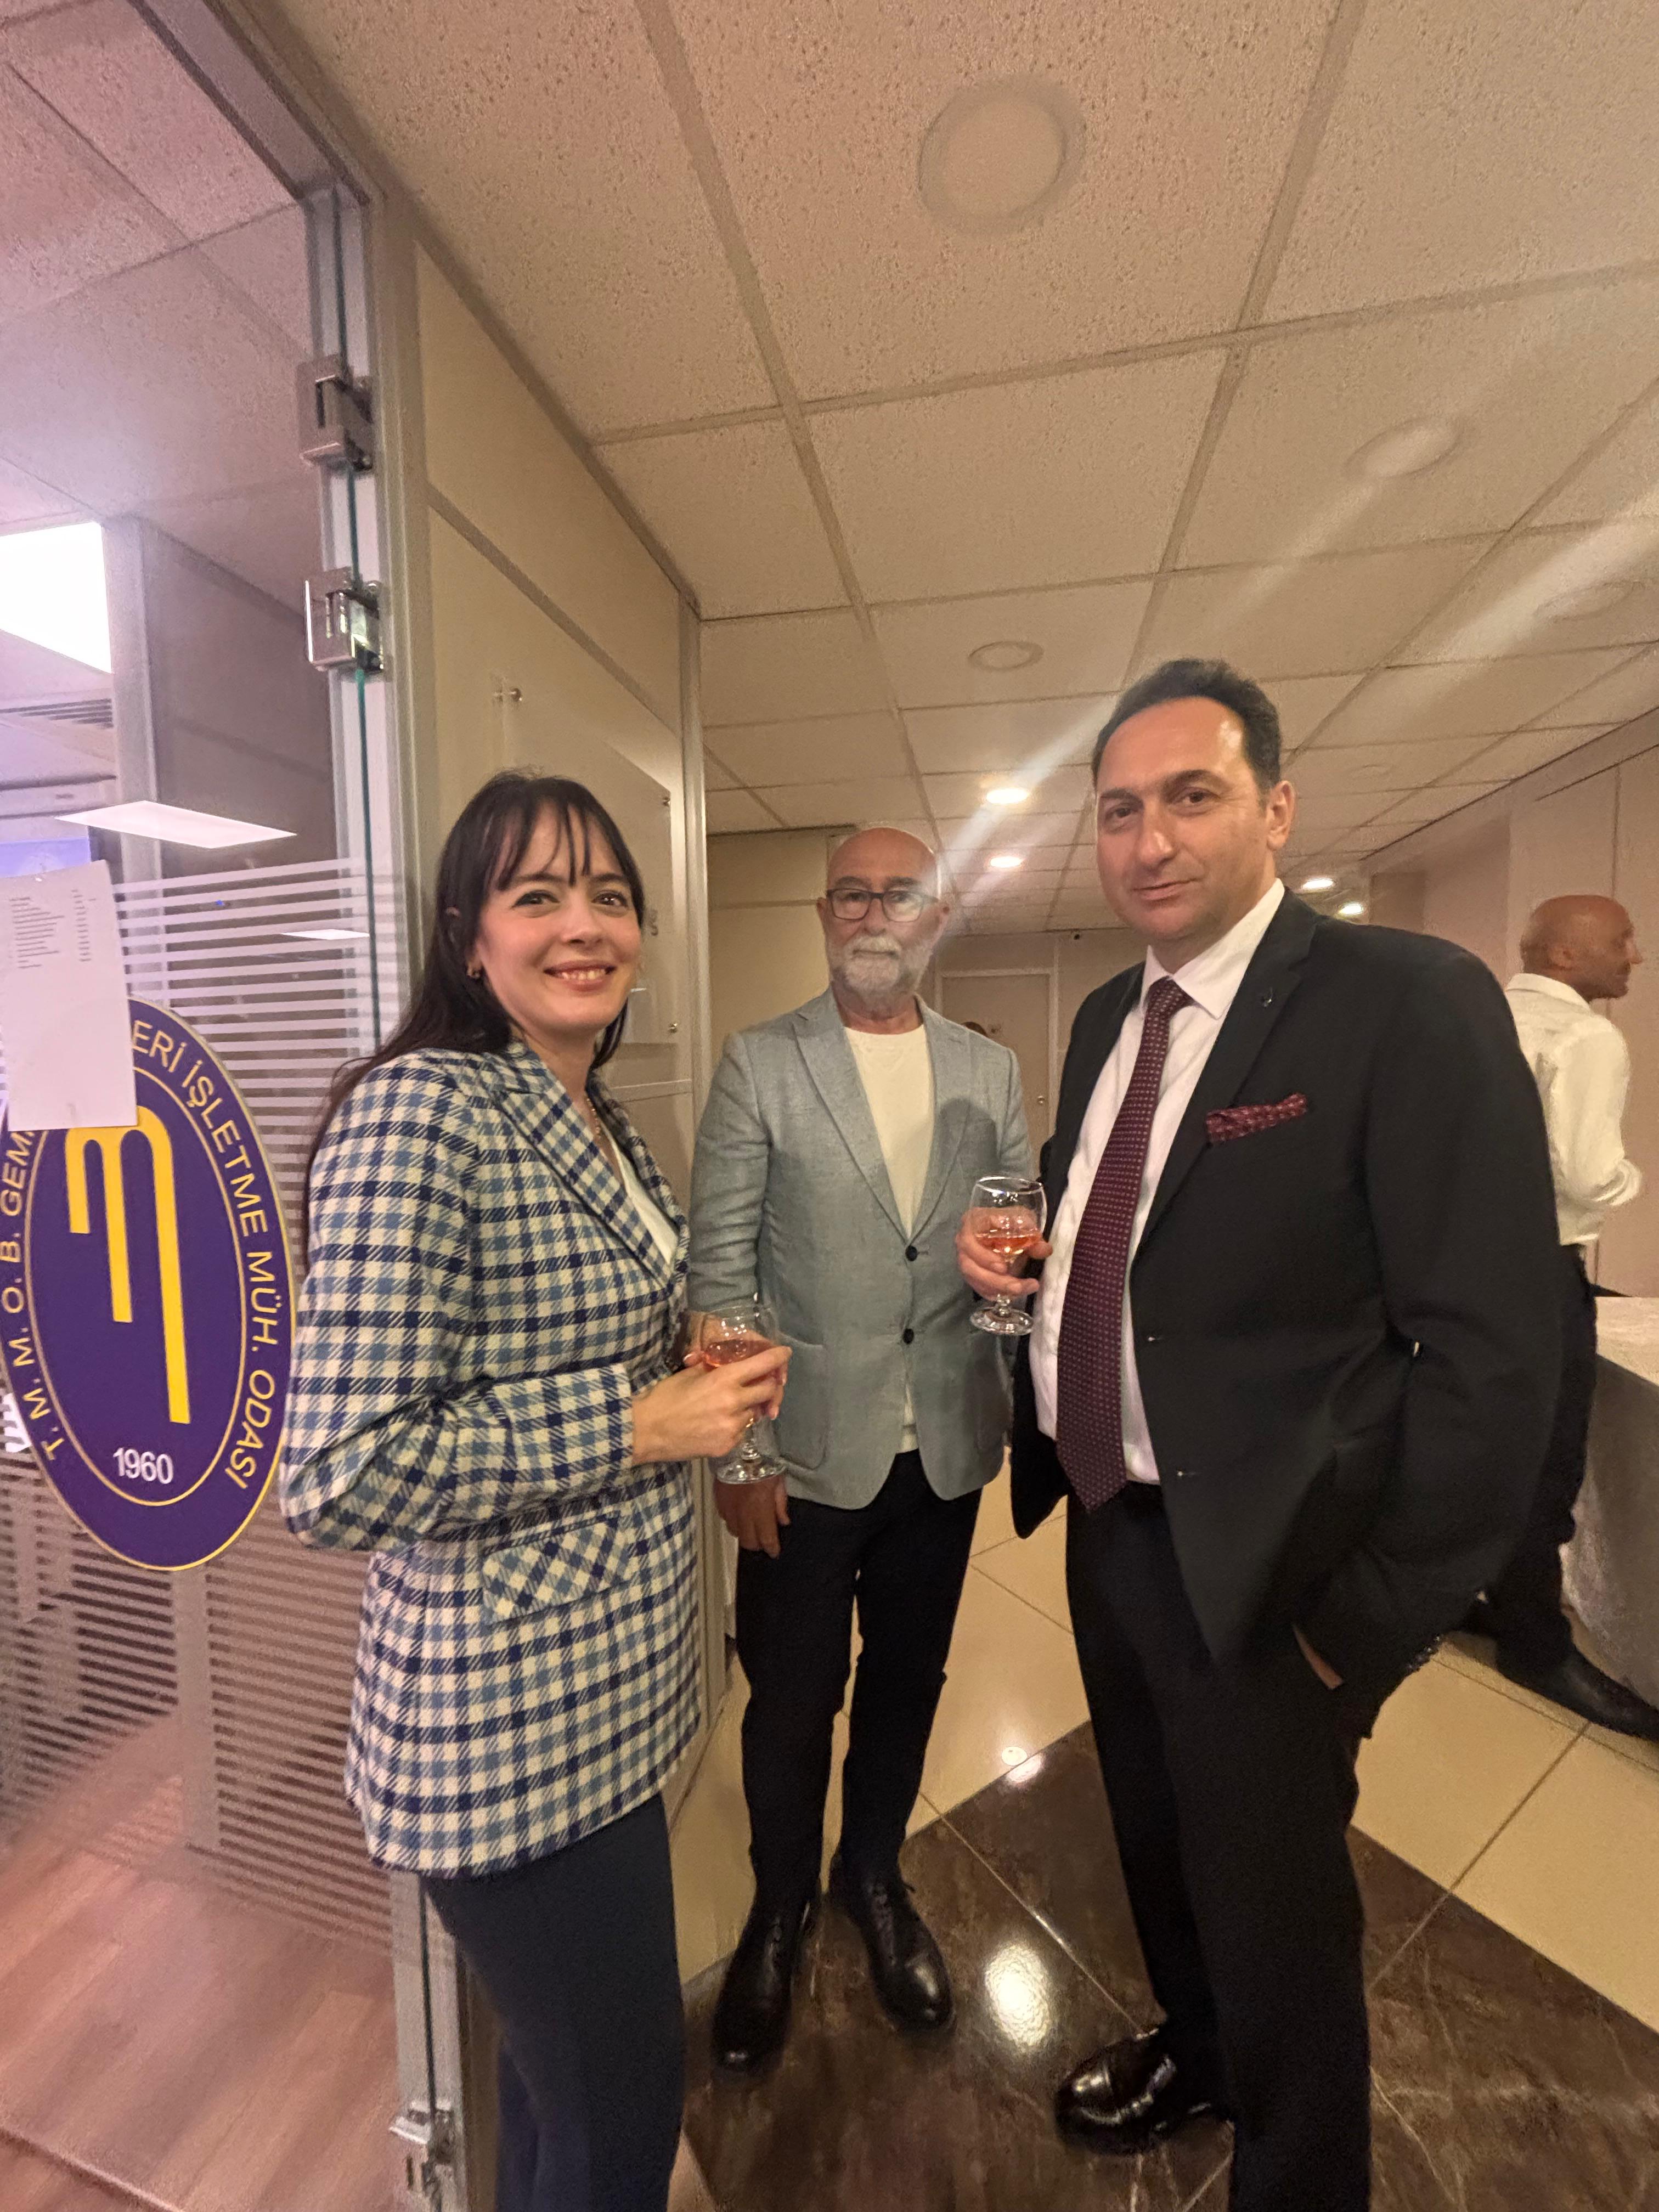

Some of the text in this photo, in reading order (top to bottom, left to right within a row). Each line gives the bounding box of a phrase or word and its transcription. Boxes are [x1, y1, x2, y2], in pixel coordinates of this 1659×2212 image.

[0, 1131, 35, 1216] GEM
[181, 1060, 269, 1237] İŞLETME
[246, 1251, 282, 1352] MÜH.
[112, 1447, 174, 1485] 1960
[224, 1369, 275, 1489] ODASI
